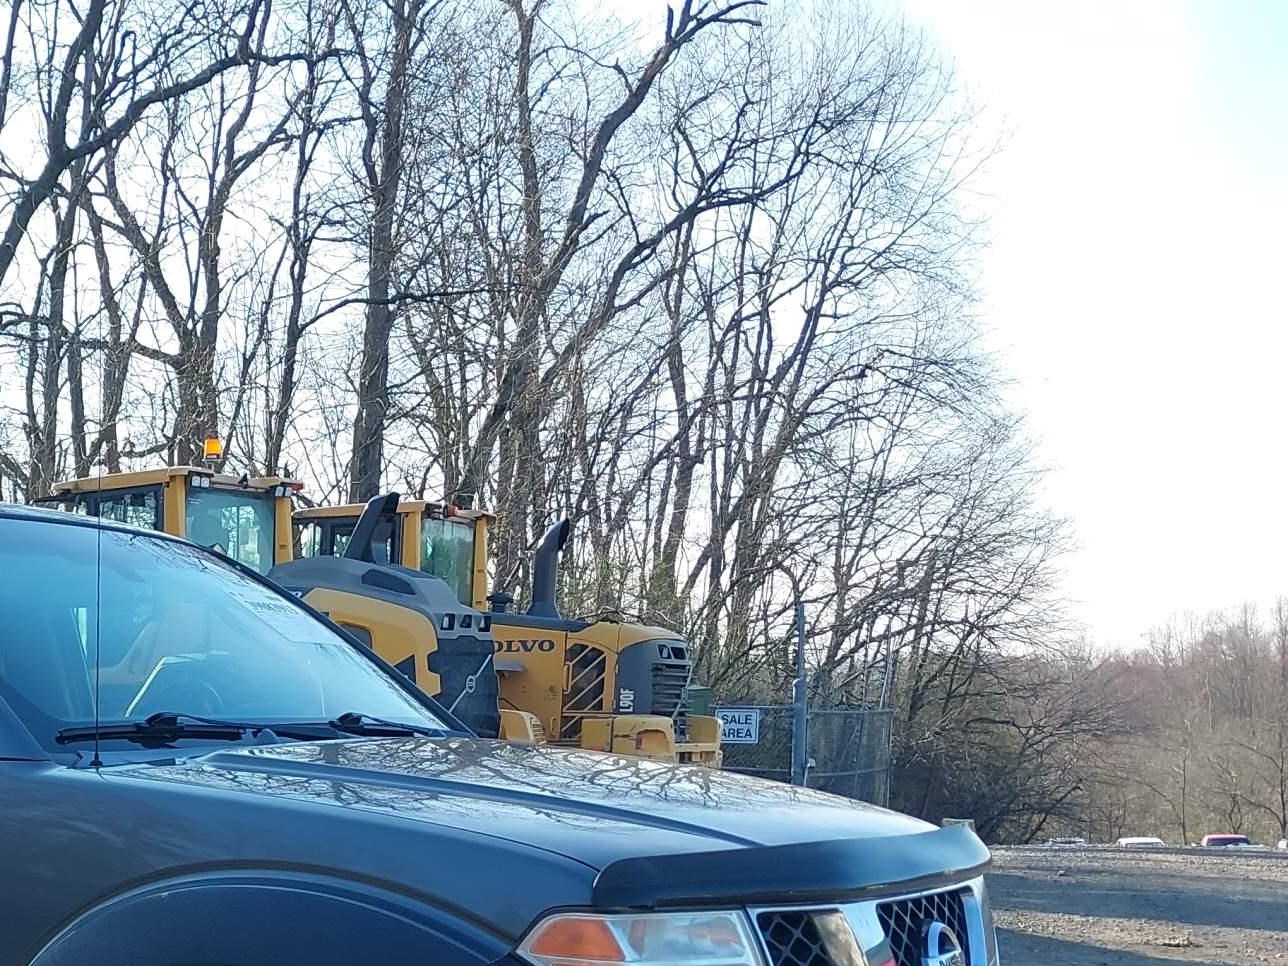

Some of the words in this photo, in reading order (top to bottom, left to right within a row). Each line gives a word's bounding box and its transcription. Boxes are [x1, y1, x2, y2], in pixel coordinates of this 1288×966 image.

[494, 639, 555, 653] OLVO
[619, 688, 635, 713] L90F
[721, 714, 753, 725] SALE
[721, 728, 753, 739] AREA
